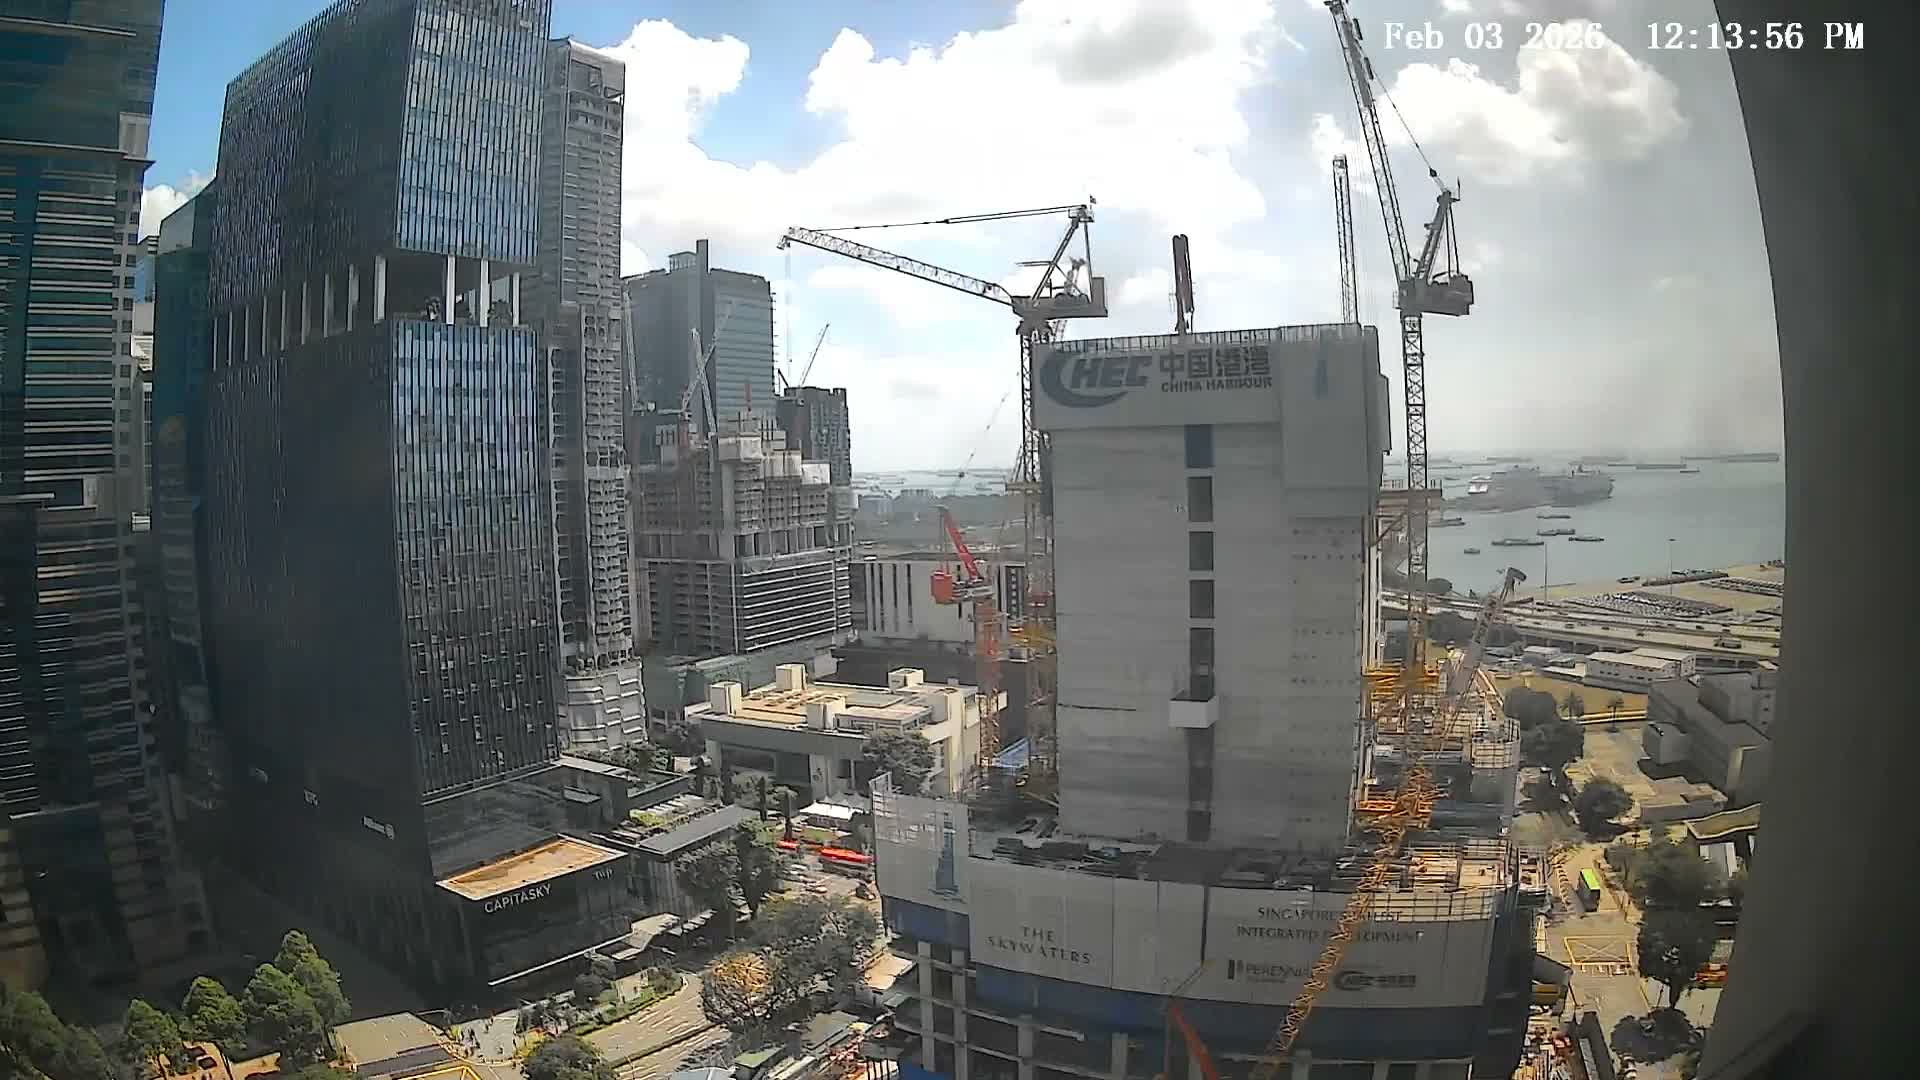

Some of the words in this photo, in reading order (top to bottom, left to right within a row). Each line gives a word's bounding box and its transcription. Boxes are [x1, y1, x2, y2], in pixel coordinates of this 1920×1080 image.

[1161, 380, 1202, 393] CHINA
[1206, 376, 1273, 391] HARBOUR
[484, 883, 551, 913] CAPITASKY
[1022, 926, 1055, 942] THE
[986, 936, 1092, 964] SKYWATERS
